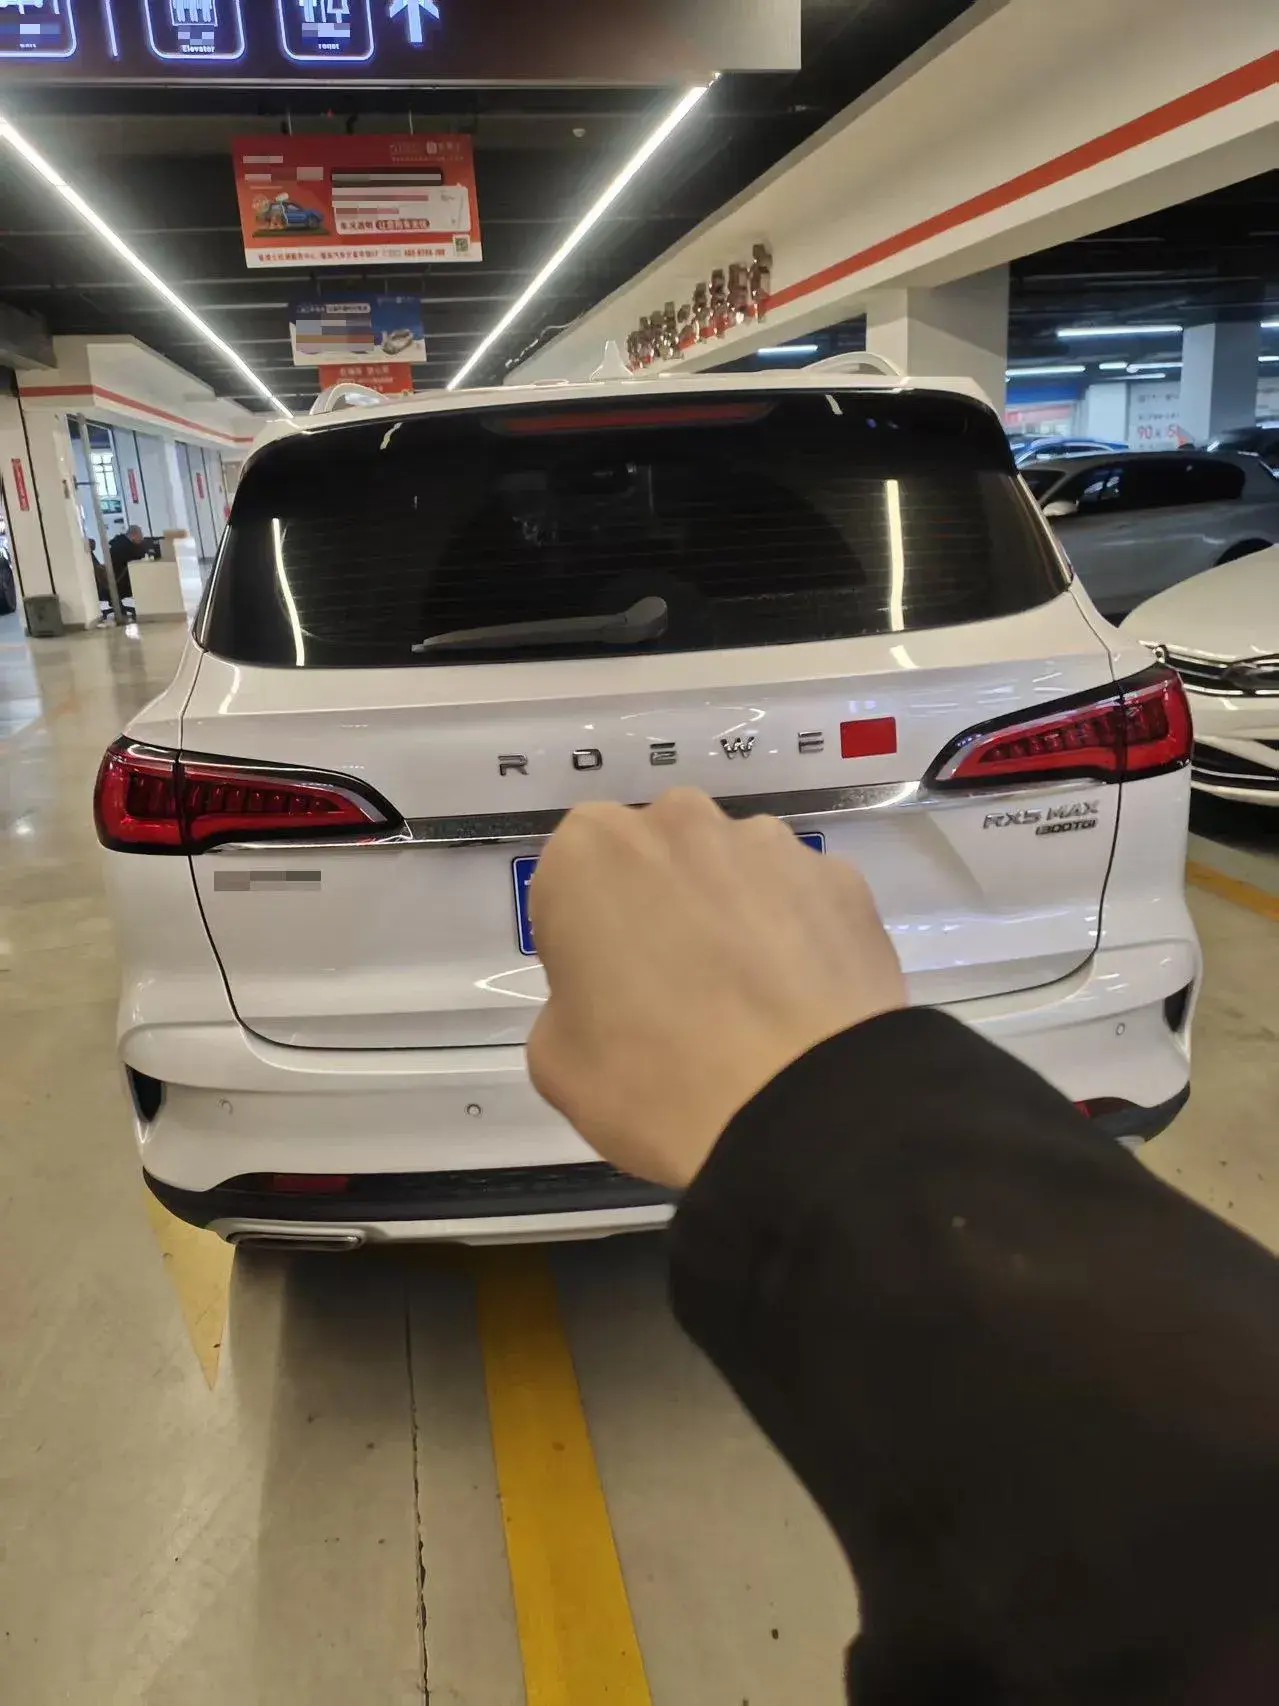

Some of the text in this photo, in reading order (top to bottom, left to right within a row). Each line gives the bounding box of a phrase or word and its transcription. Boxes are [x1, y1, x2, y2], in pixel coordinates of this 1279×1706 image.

[181, 45, 216, 53] Elevator
[498, 731, 825, 777] ROEWE
[983, 801, 1099, 829] RX5 MAX
